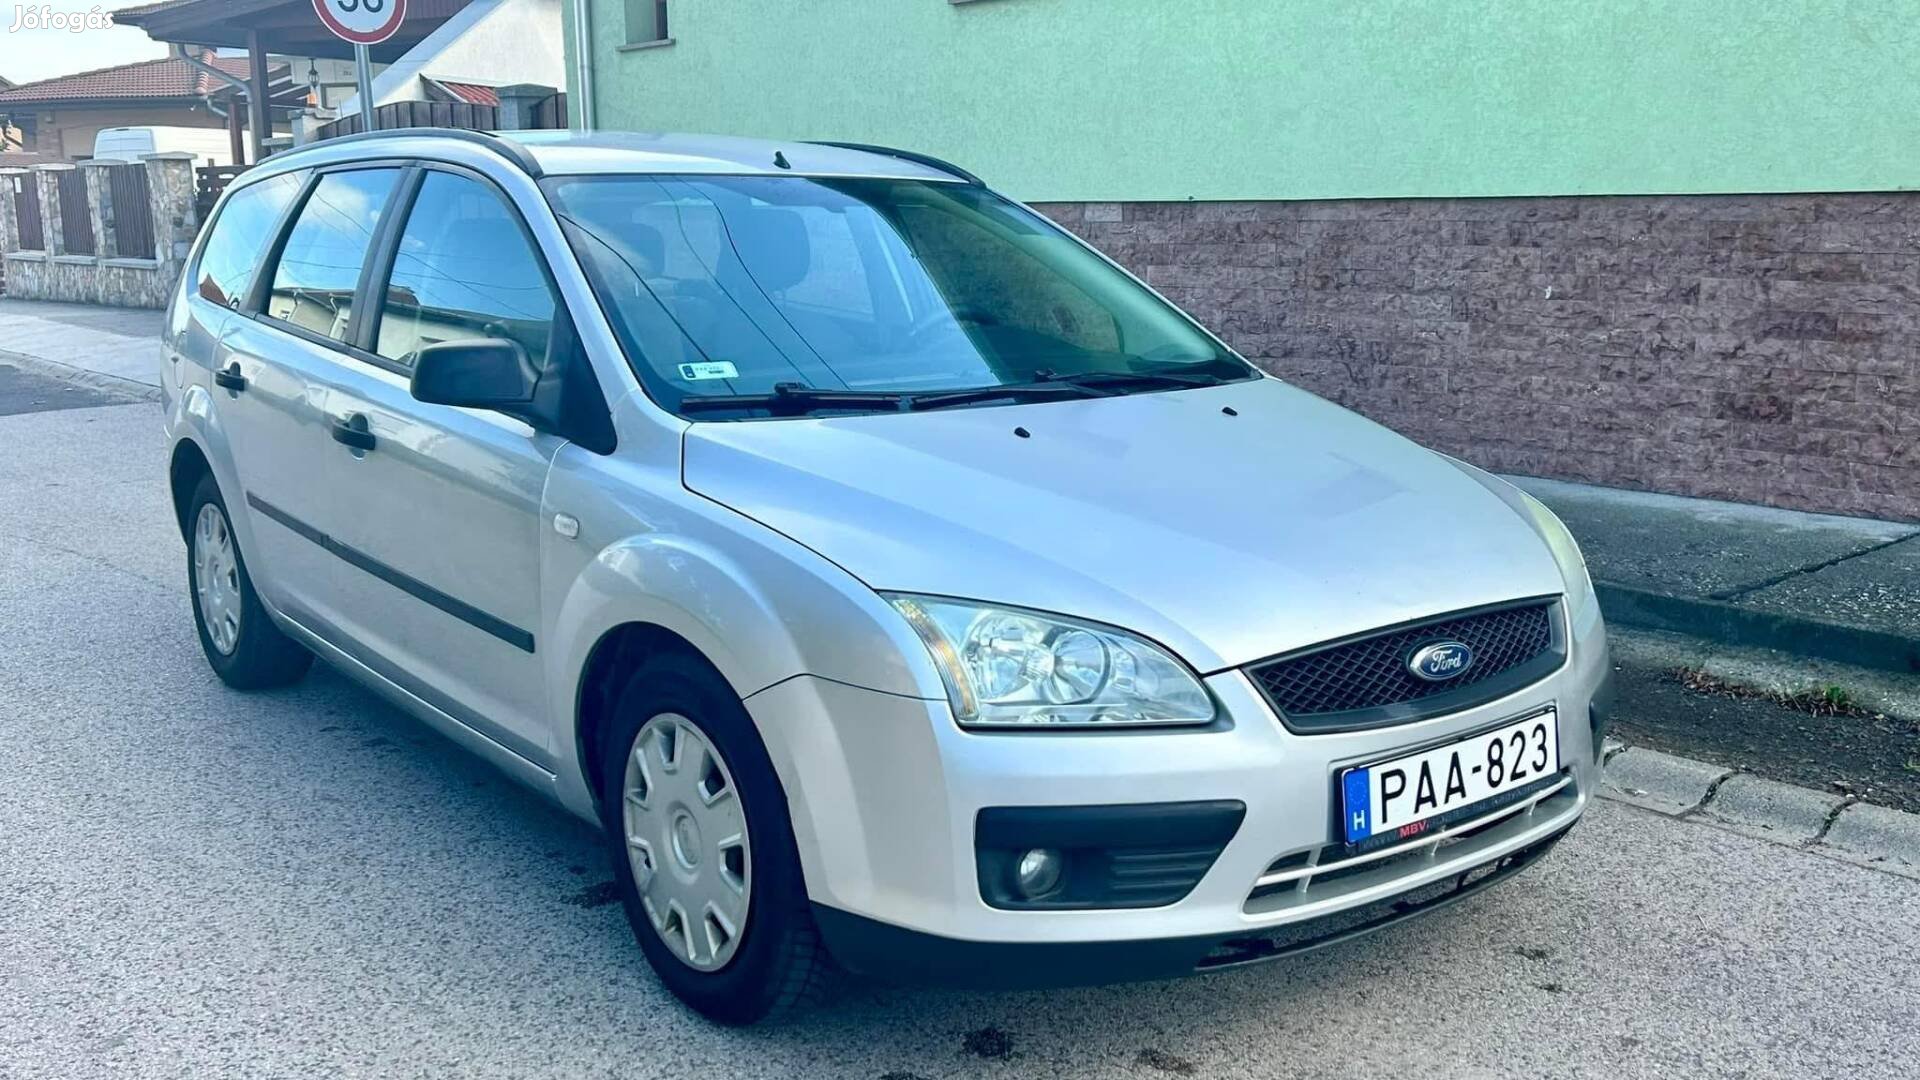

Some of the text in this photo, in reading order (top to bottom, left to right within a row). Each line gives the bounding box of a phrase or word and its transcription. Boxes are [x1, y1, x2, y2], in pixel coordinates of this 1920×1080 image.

[1430, 650, 1461, 672] Ford
[1381, 723, 1548, 824] PAA-823
[1353, 810, 1365, 831] H
